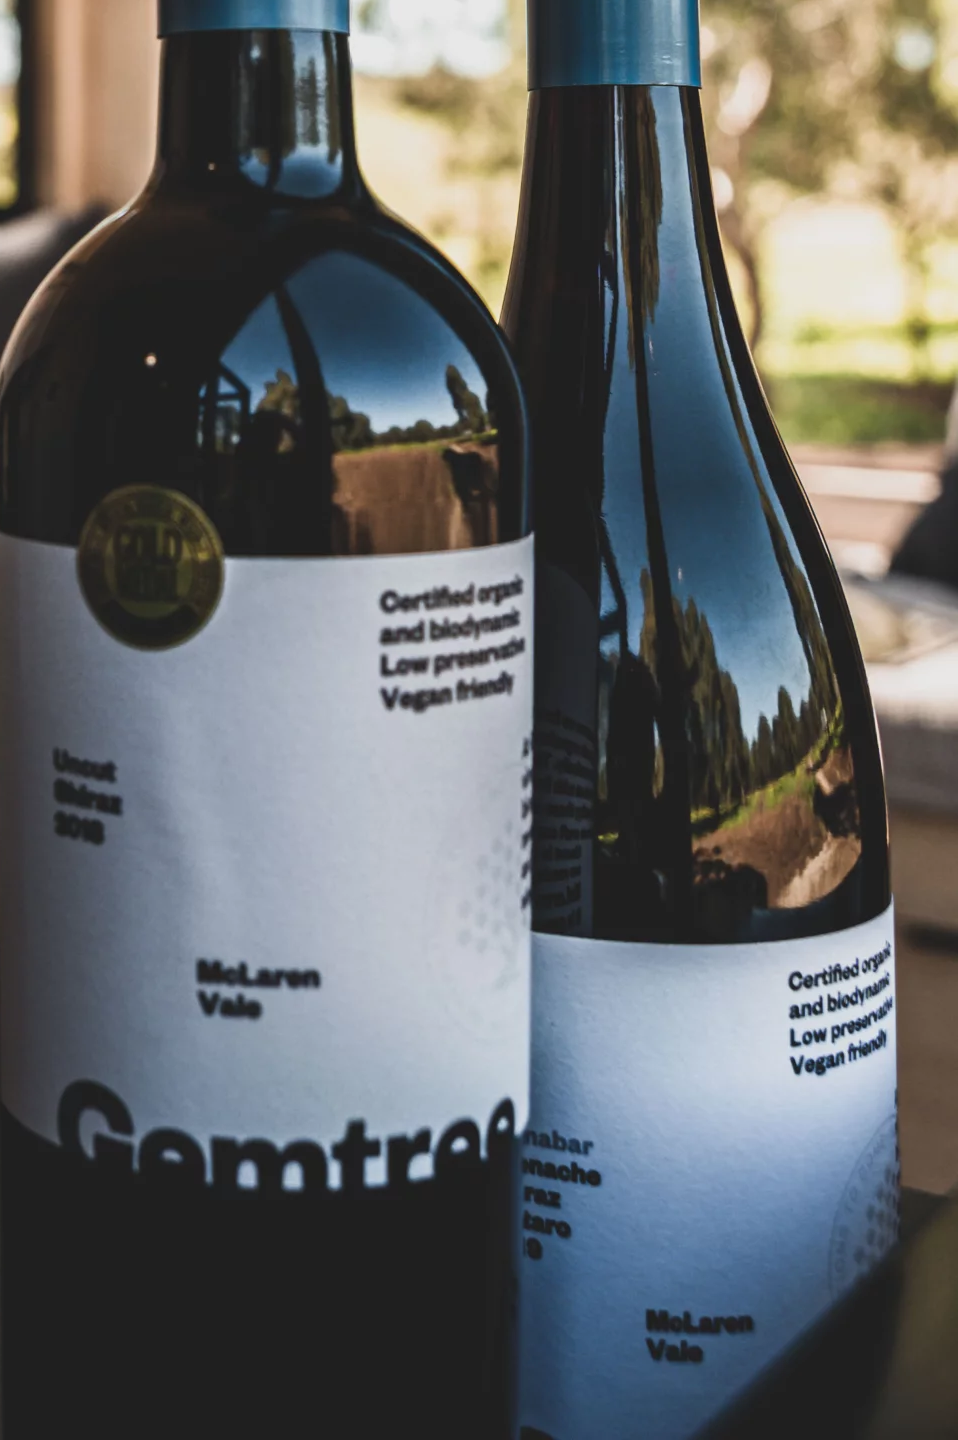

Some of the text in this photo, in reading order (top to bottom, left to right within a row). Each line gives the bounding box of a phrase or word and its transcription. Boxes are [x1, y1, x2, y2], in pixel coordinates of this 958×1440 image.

[379, 582, 475, 614] Certified
[379, 619, 425, 645] and
[379, 653, 430, 677] Low
[379, 686, 453, 714] Vegan
[53, 777, 124, 817] Shiraz
[196, 958, 321, 990] McLaren
[788, 957, 859, 992] Certified
[197, 990, 263, 1022] Vale
[788, 995, 824, 1020] and
[789, 1027, 827, 1048] Low
[790, 1029, 887, 1076] Vegan friendly
[57, 1078, 517, 1192] Gemtree
[645, 1308, 755, 1336] McLaren
[645, 1337, 705, 1365] Vale
